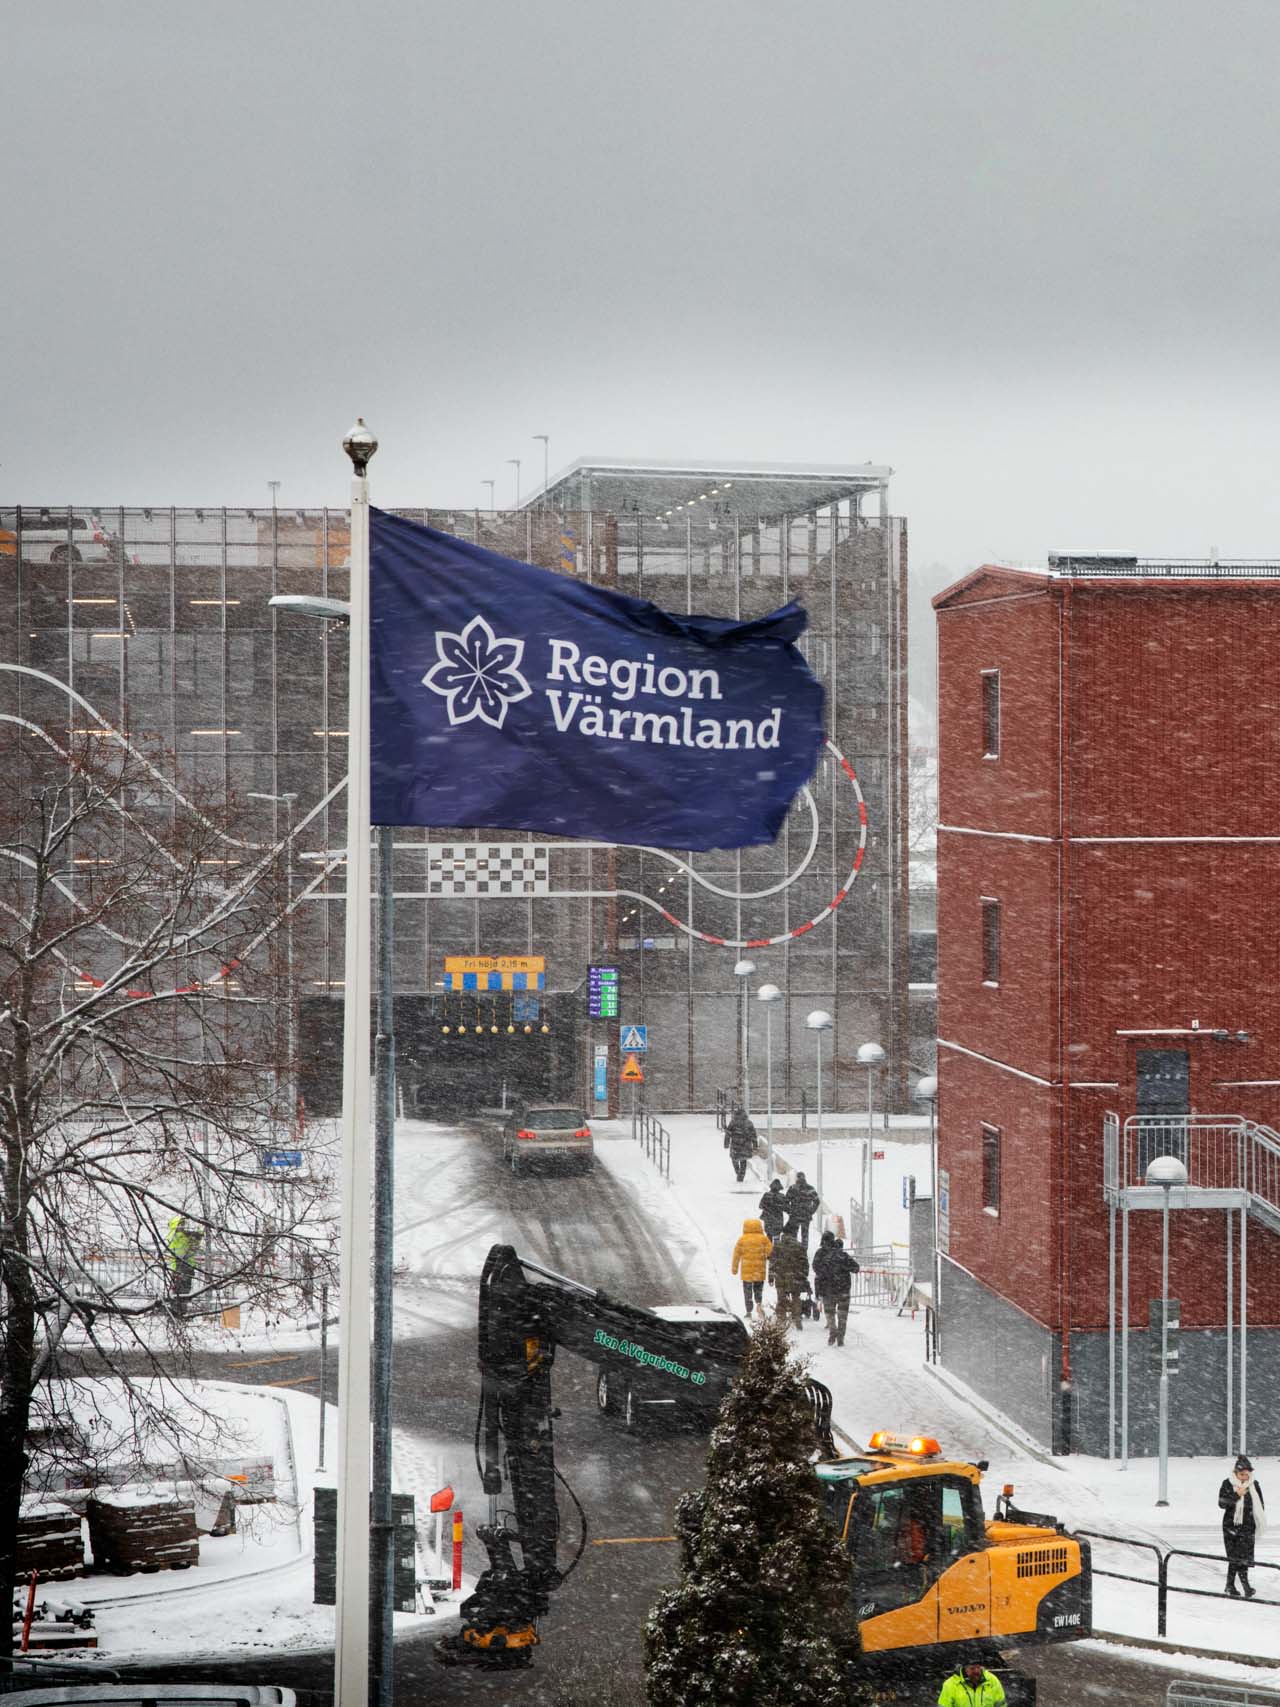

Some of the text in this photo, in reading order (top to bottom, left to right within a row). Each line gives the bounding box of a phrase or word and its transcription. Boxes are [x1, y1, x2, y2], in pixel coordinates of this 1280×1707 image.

[547, 639, 723, 701] Region
[546, 689, 782, 749] Värmland
[594, 1329, 705, 1385] Sten & Vägarbeten ab
[1054, 1613, 1081, 1628] EW140E
